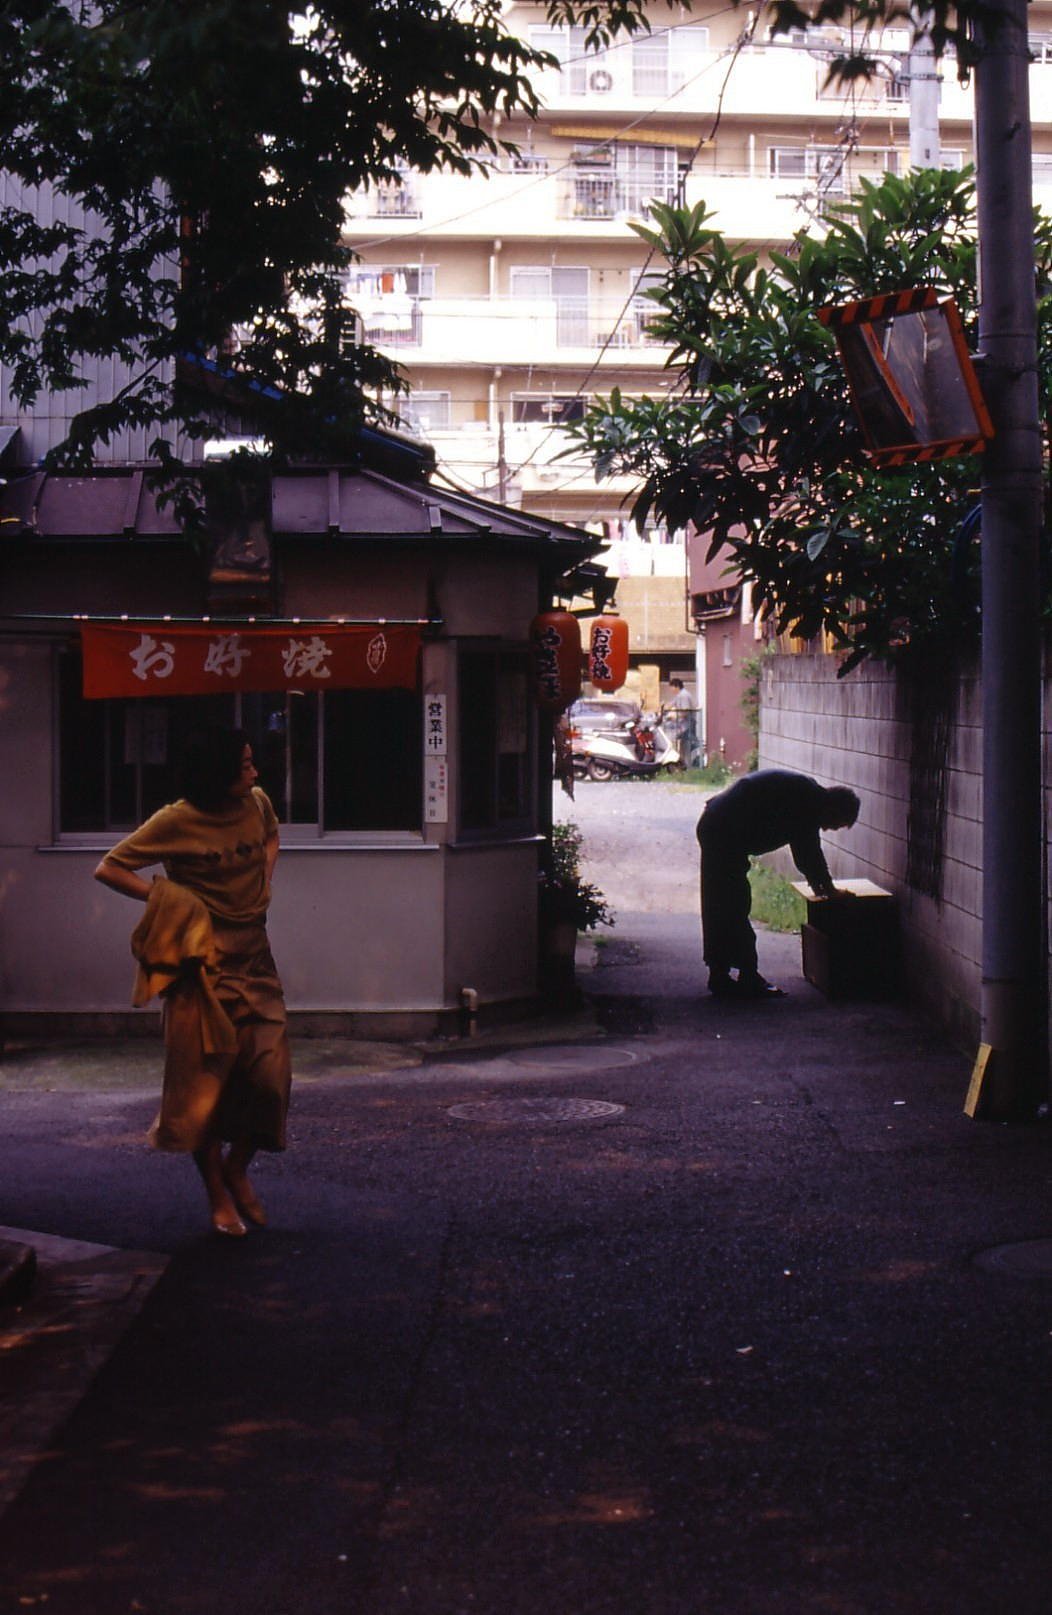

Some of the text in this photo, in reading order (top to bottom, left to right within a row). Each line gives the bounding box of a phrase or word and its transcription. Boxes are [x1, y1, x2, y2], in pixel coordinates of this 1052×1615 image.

[129, 633, 331, 679] お好焼
[592, 627, 613, 680] お好焼
[428, 702, 443, 749] 営業中
